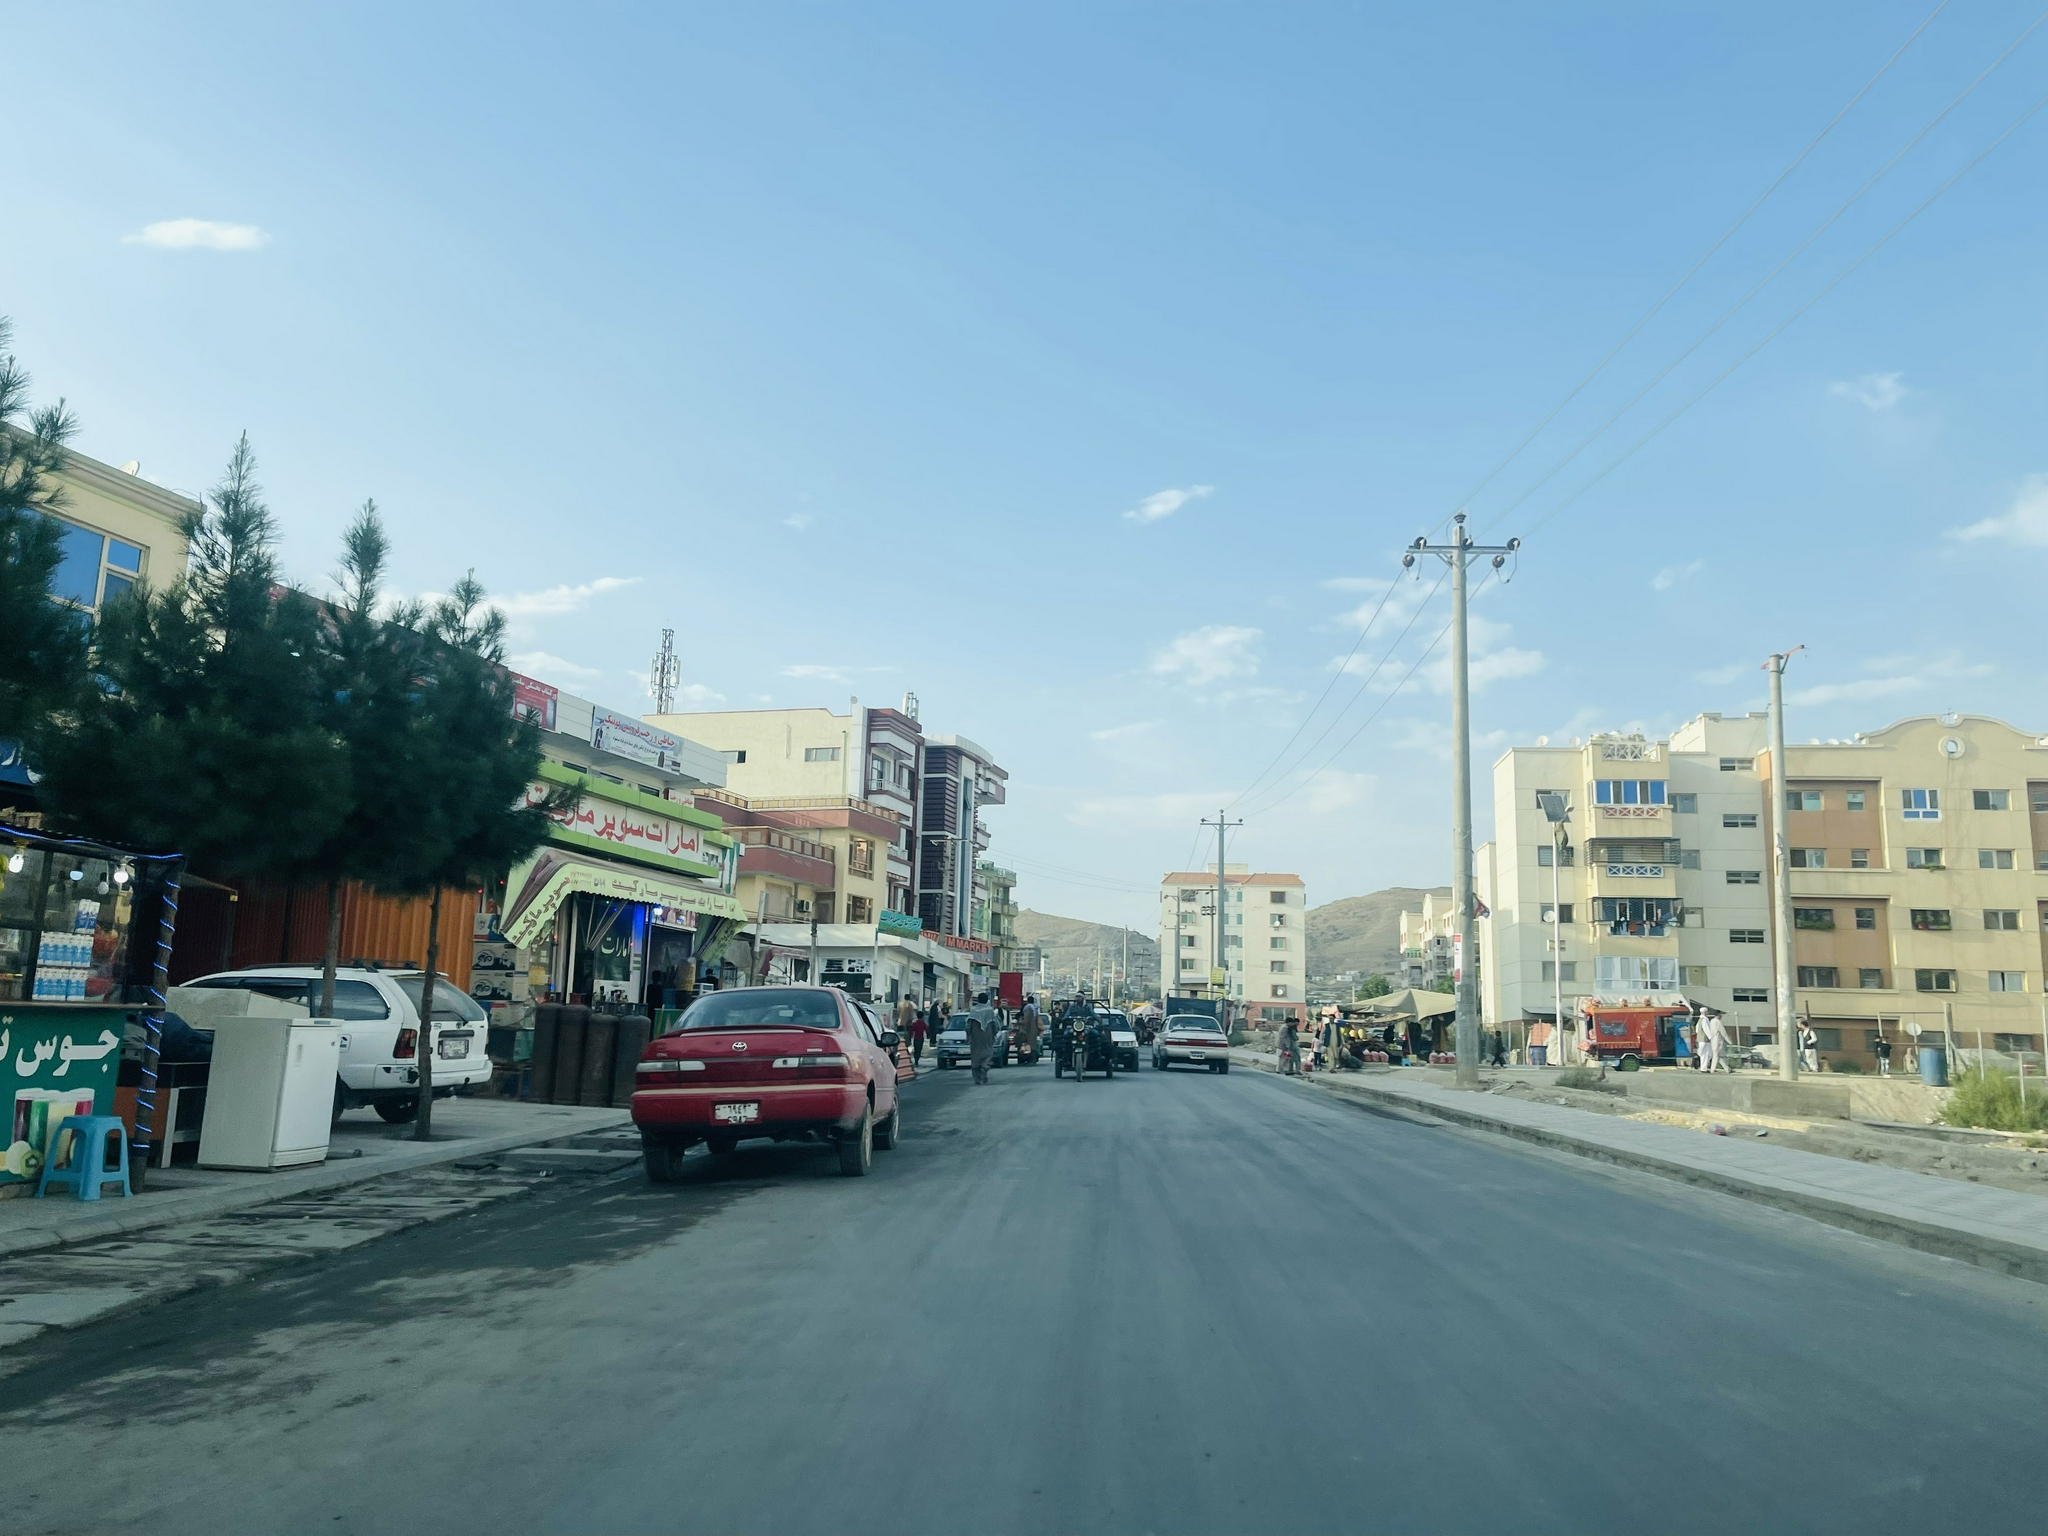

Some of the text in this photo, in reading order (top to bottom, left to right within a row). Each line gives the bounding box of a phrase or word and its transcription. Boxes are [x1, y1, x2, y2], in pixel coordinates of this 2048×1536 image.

[593, 813, 644, 842] سوپر
[645, 819, 701, 855] امارات
[601, 936, 631, 957] امارات
[956, 938, 992, 955] MARKET
[15, 1028, 120, 1077] جوس
